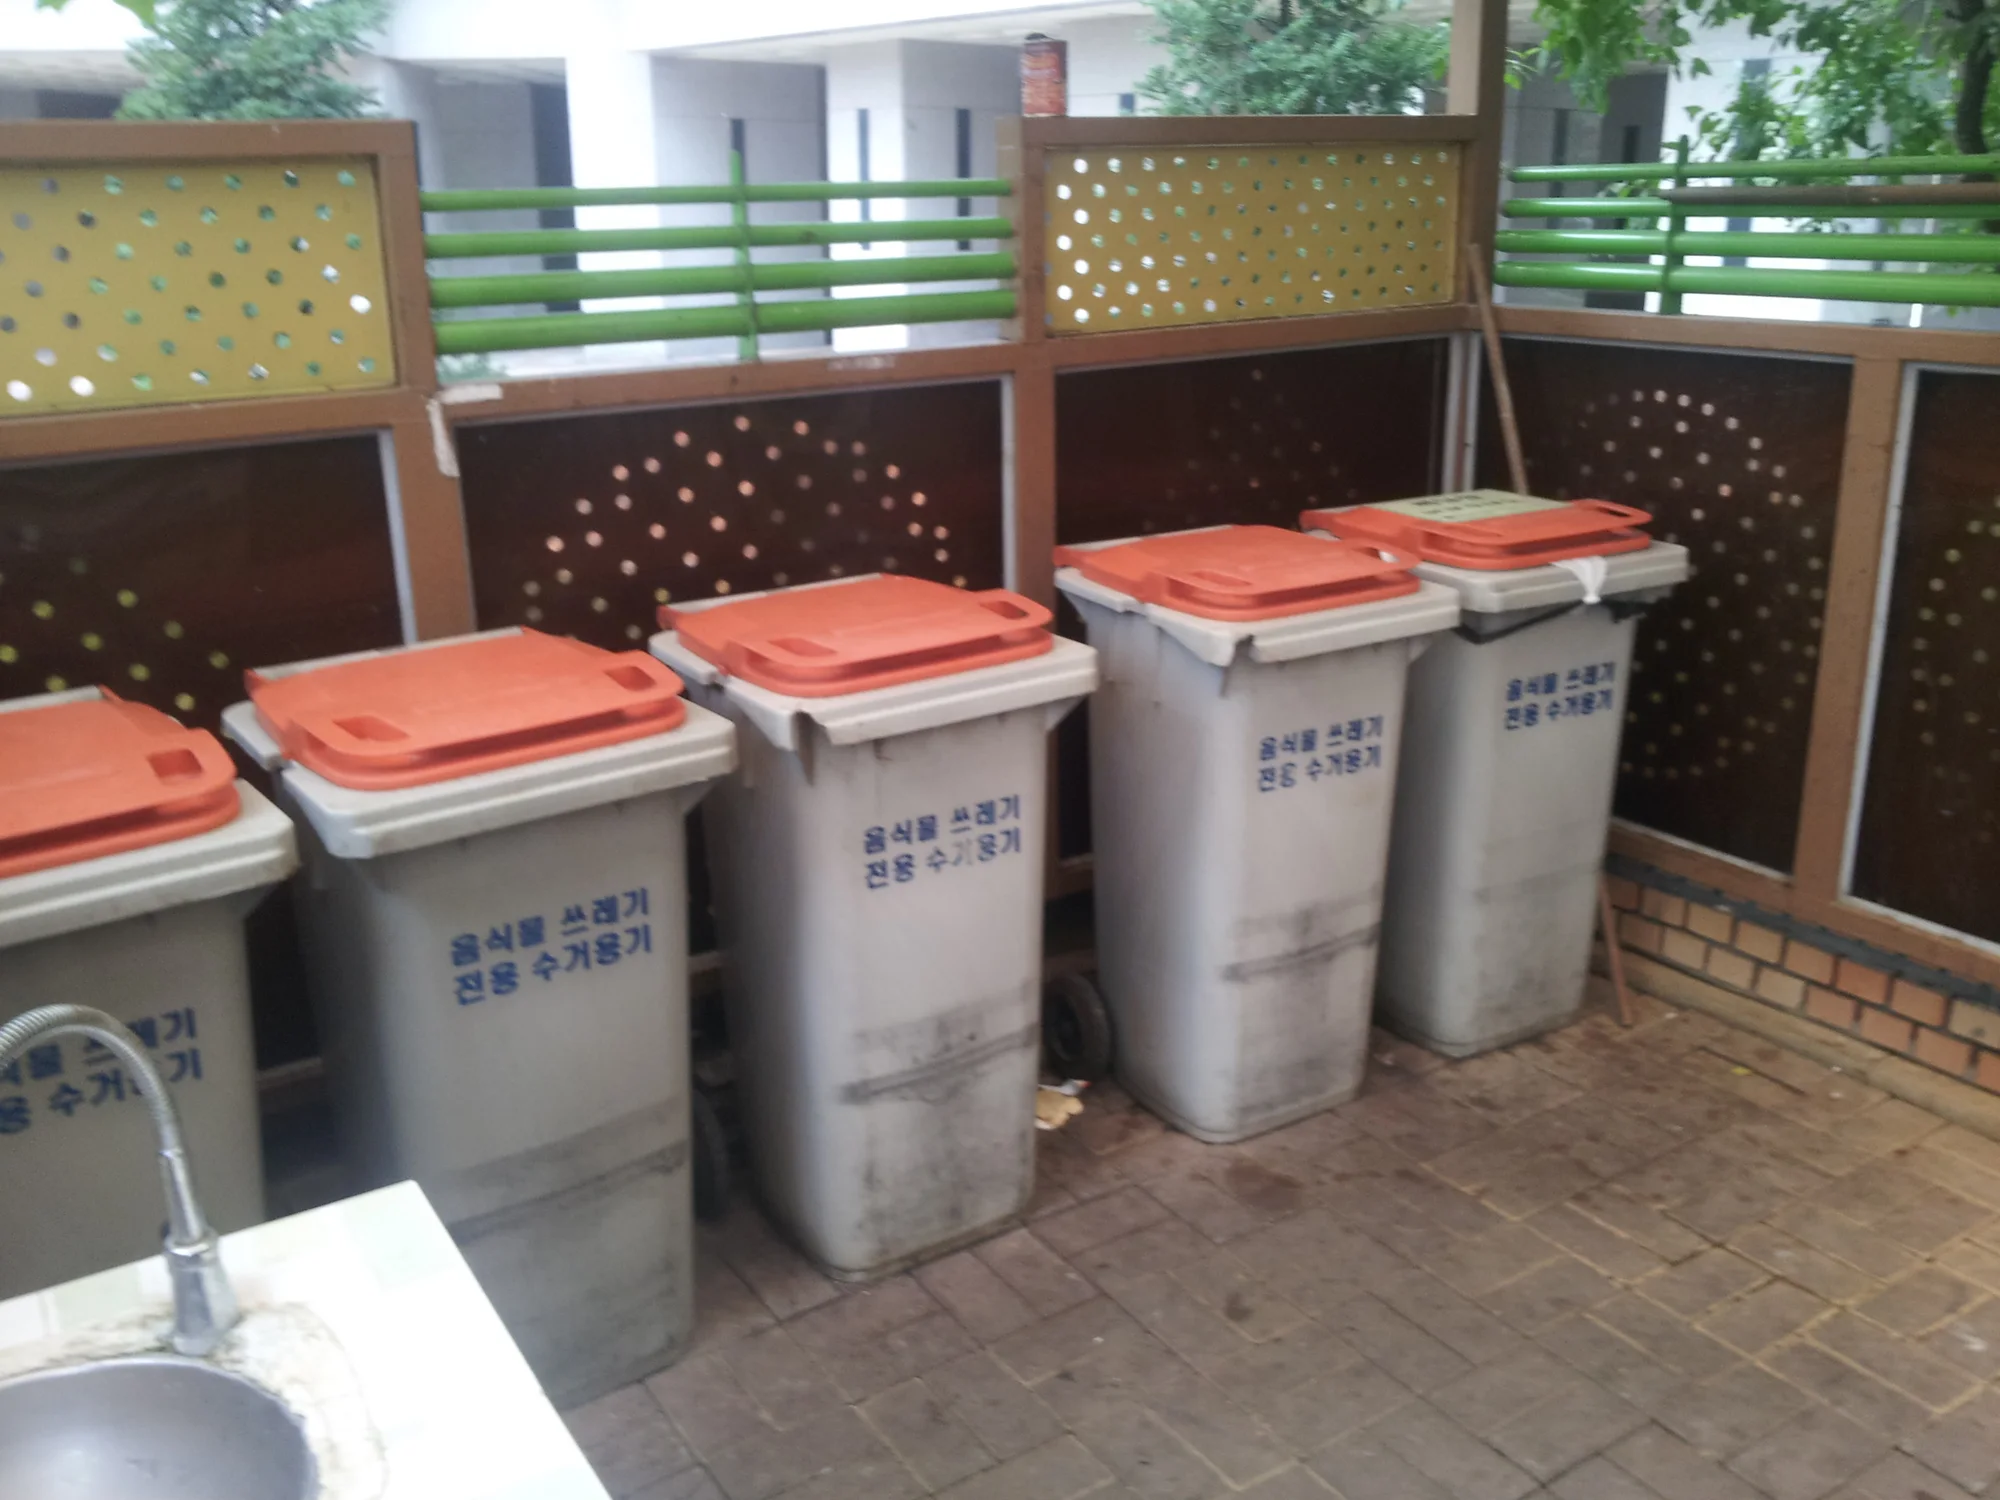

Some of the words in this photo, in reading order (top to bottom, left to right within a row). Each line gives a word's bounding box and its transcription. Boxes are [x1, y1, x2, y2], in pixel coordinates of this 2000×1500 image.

[1260, 729, 1317, 761] 음식물
[1326, 715, 1383, 747] 쓰레기
[864, 814, 937, 855] 음식물
[950, 795, 1020, 834] 쓰레기
[866, 853, 914, 889] 전용
[452, 915, 546, 967] 음식물
[561, 886, 649, 936] 쓰레기
[454, 961, 520, 1006] 전용
[531, 924, 652, 982] 수거용기
